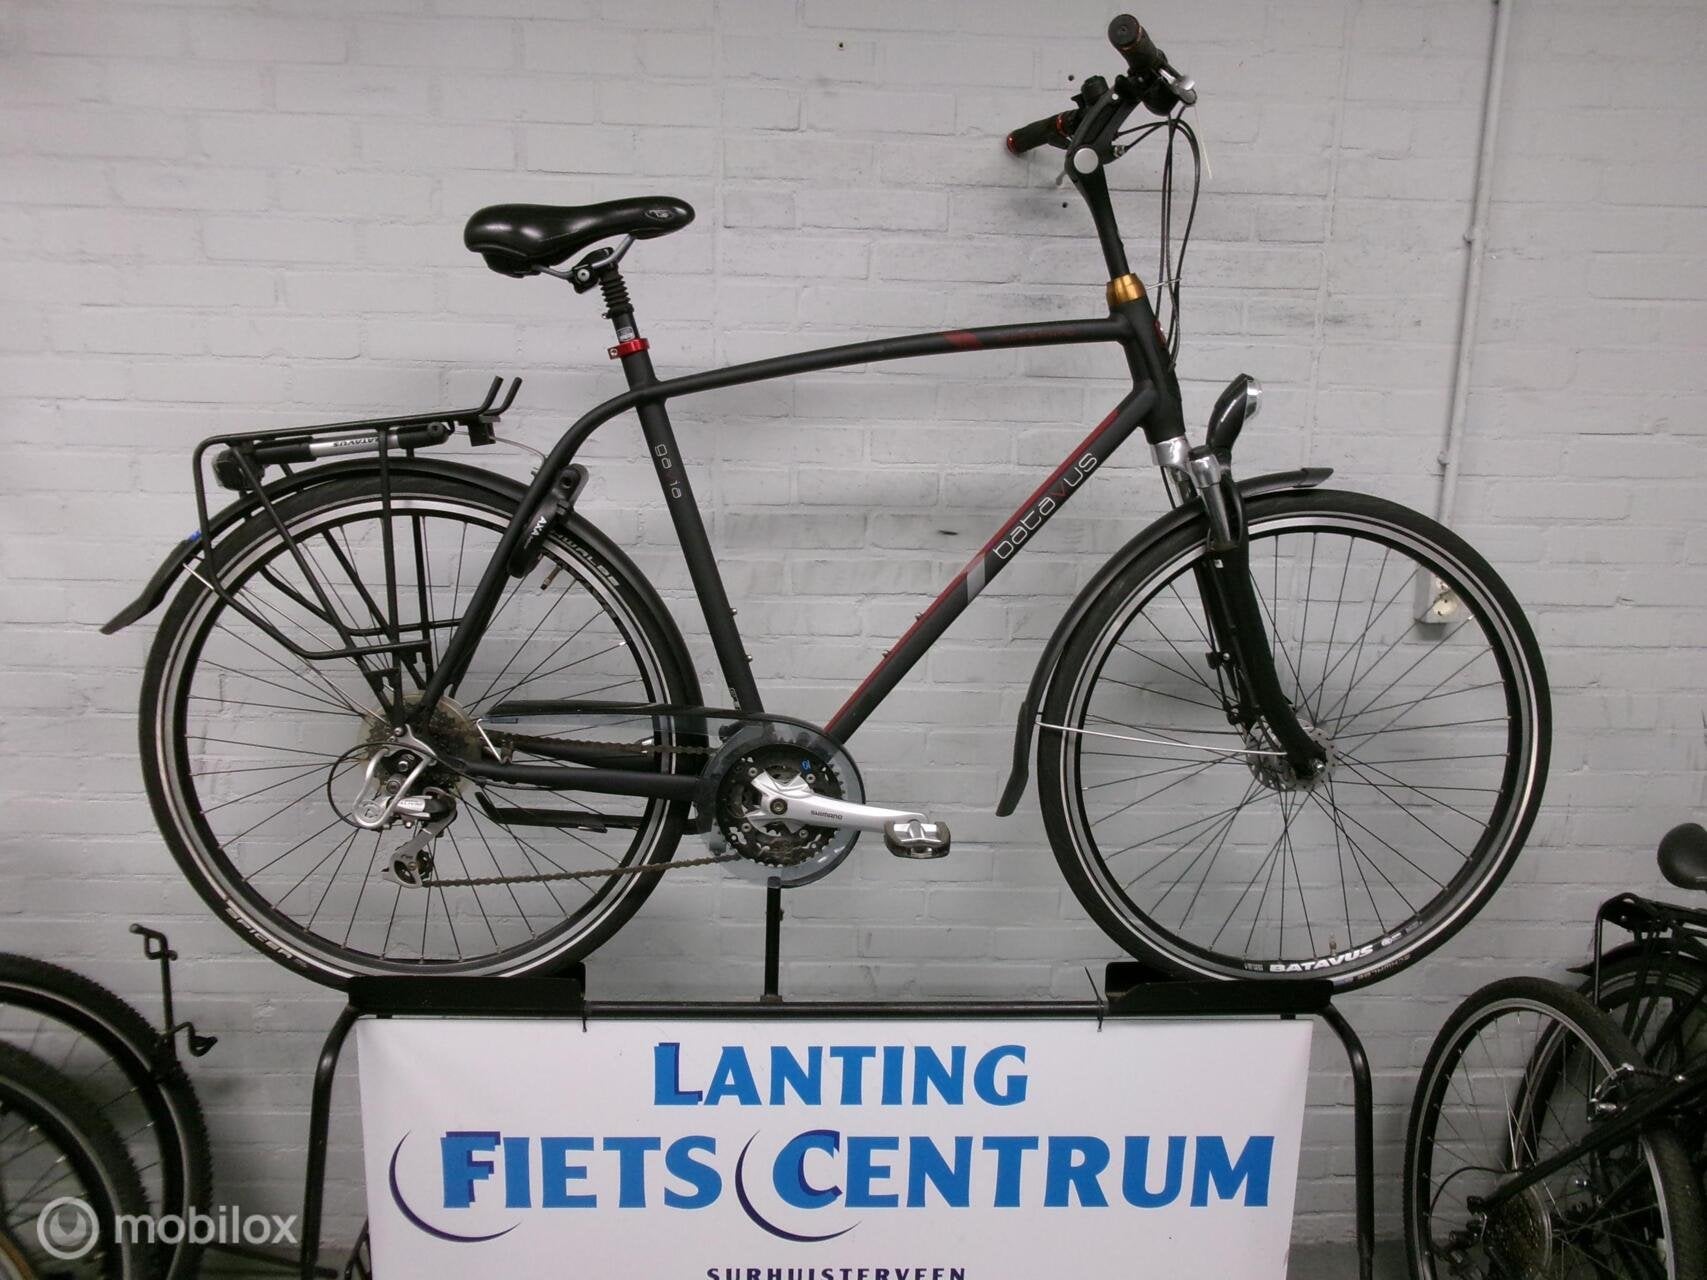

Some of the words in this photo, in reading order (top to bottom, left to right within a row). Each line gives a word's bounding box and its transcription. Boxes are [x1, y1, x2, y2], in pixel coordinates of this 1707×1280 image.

[532, 516, 547, 536] AXA
[1269, 944, 1374, 973] BATAVUS
[653, 1042, 1028, 1106] LANTING
[440, 1130, 722, 1209] FIETS
[772, 1128, 1275, 1209] CENTRUM
